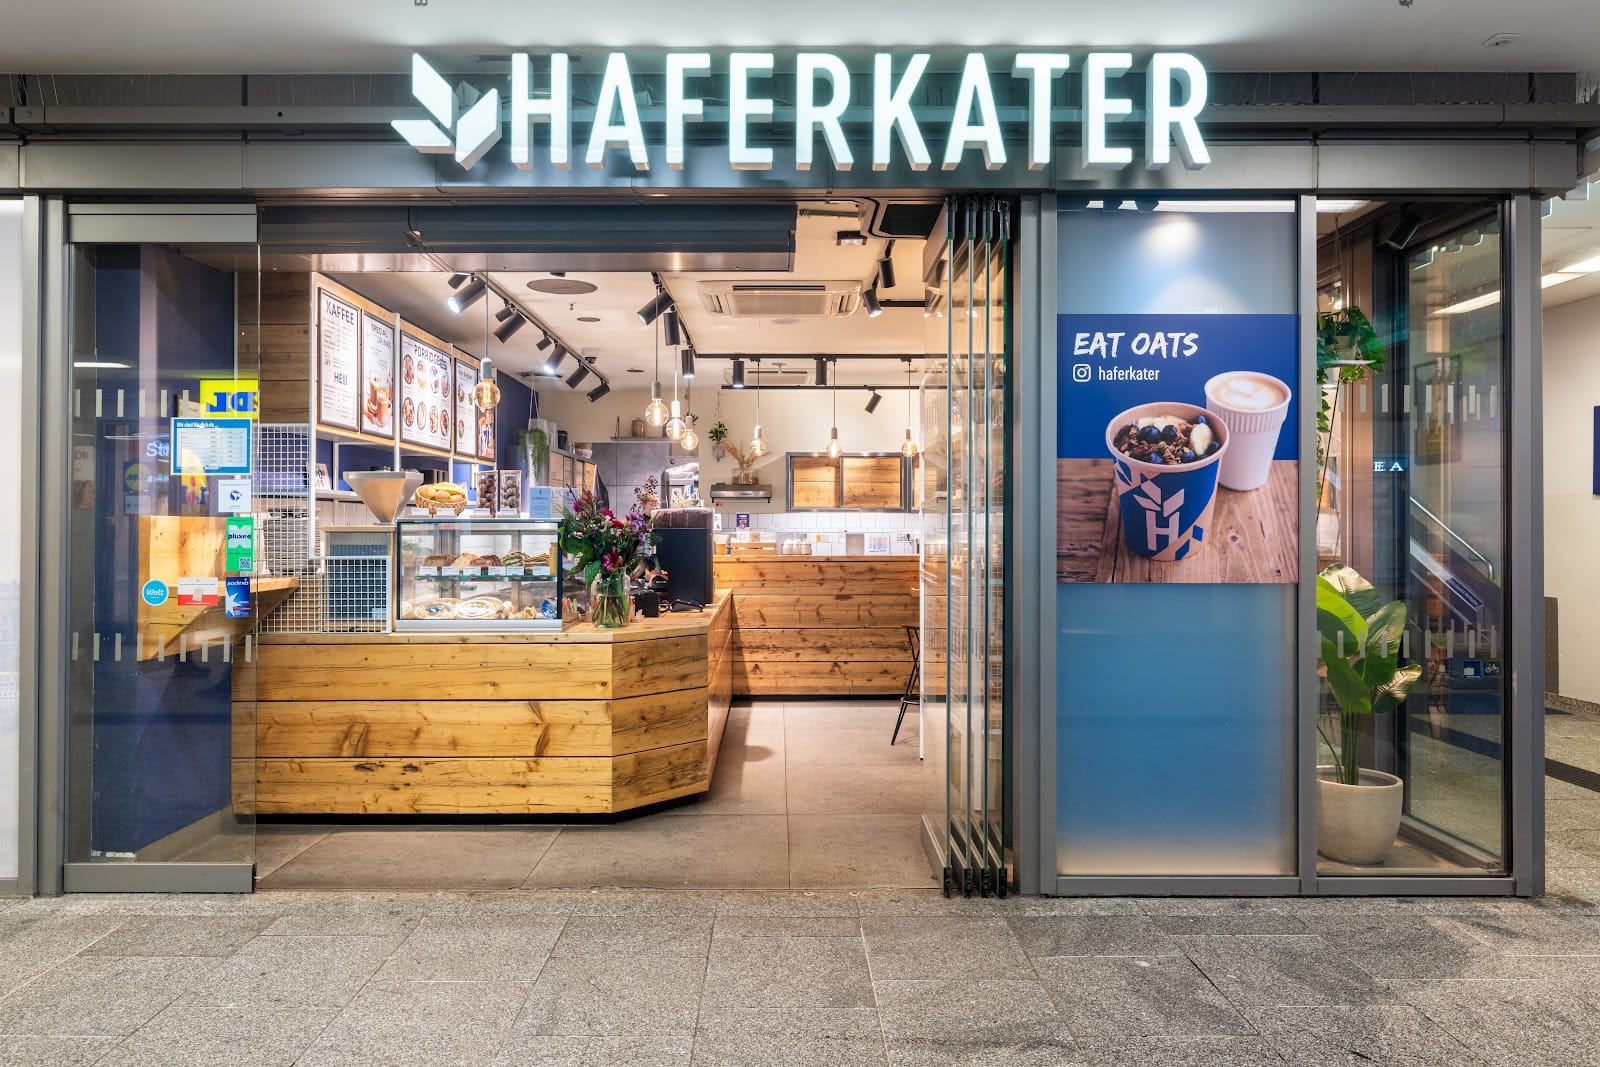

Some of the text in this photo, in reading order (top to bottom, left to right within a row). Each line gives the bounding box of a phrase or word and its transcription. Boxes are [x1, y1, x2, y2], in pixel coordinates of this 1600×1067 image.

[510, 52, 1211, 167] HAFERKATER
[326, 300, 355, 326] KAFFEE
[1073, 331, 1199, 359] EAT OATS
[1098, 365, 1161, 381] haferkater
